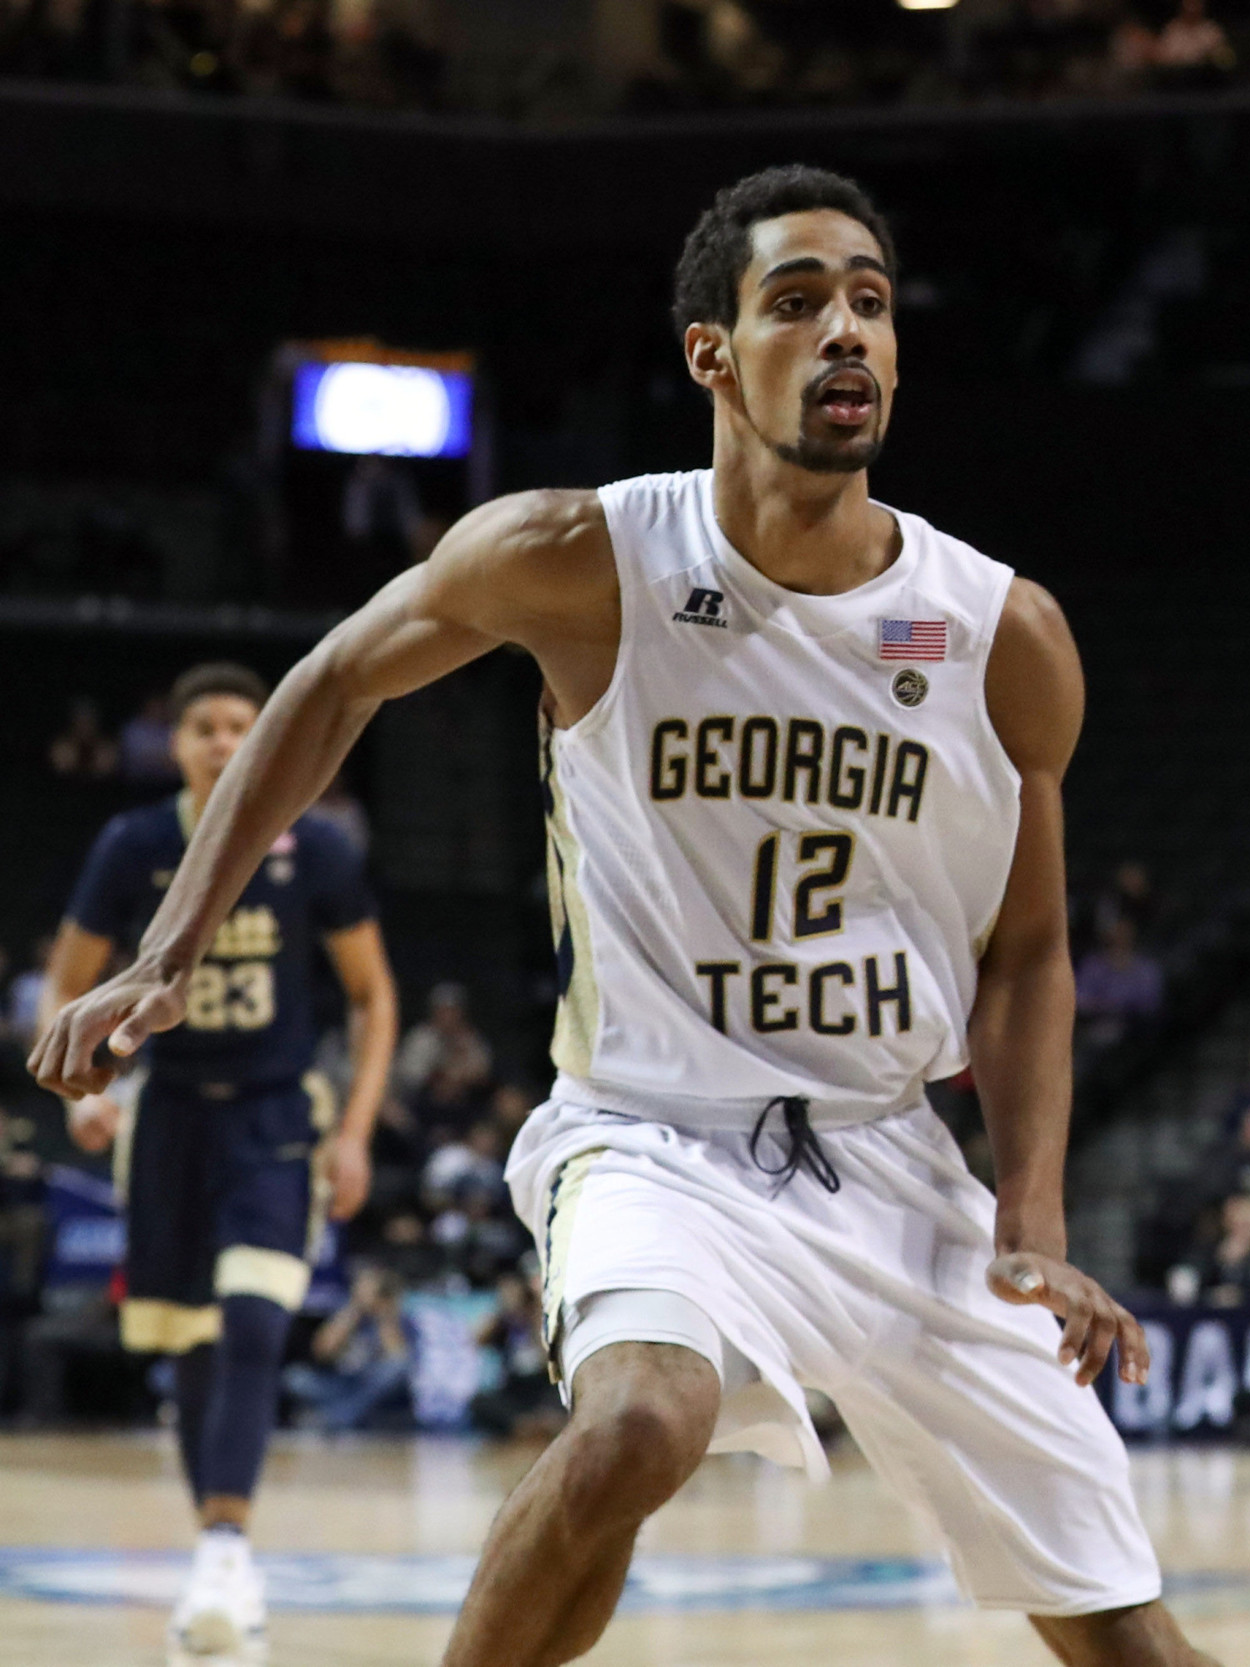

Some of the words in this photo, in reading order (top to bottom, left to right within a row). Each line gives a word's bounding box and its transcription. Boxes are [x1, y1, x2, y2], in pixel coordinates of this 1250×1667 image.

[650, 715, 929, 823] GEORGIA
[748, 829, 856, 943] 12
[187, 963, 275, 1030] 23
[696, 950, 912, 1038] TECH
